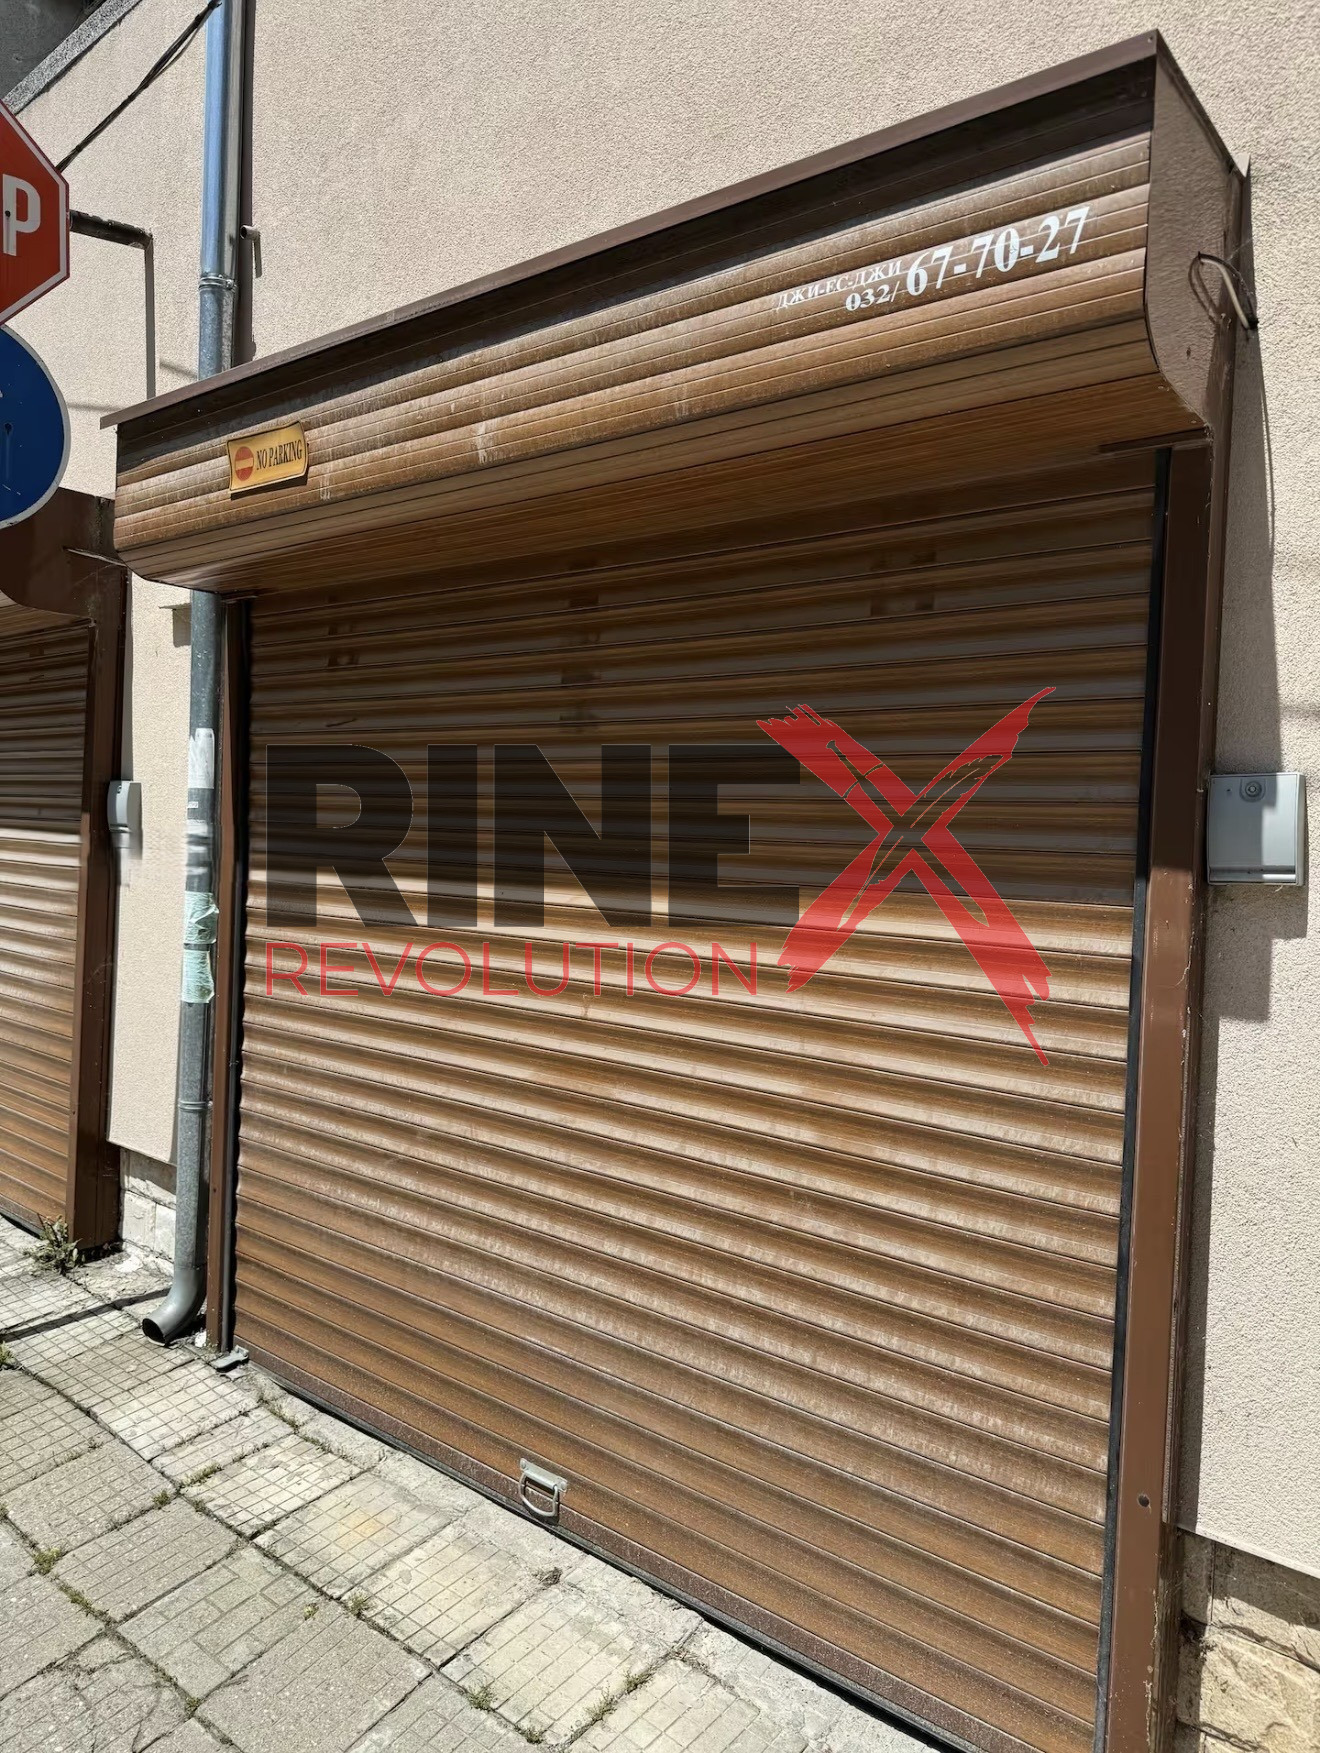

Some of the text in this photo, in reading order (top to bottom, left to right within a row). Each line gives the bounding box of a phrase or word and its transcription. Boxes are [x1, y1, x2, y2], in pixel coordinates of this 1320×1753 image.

[906, 206, 1091, 297] 67-70-27
[775, 259, 903, 311] ДЖИ-ЕС-ДЖИ
[256, 439, 303, 470] NO PARKING
